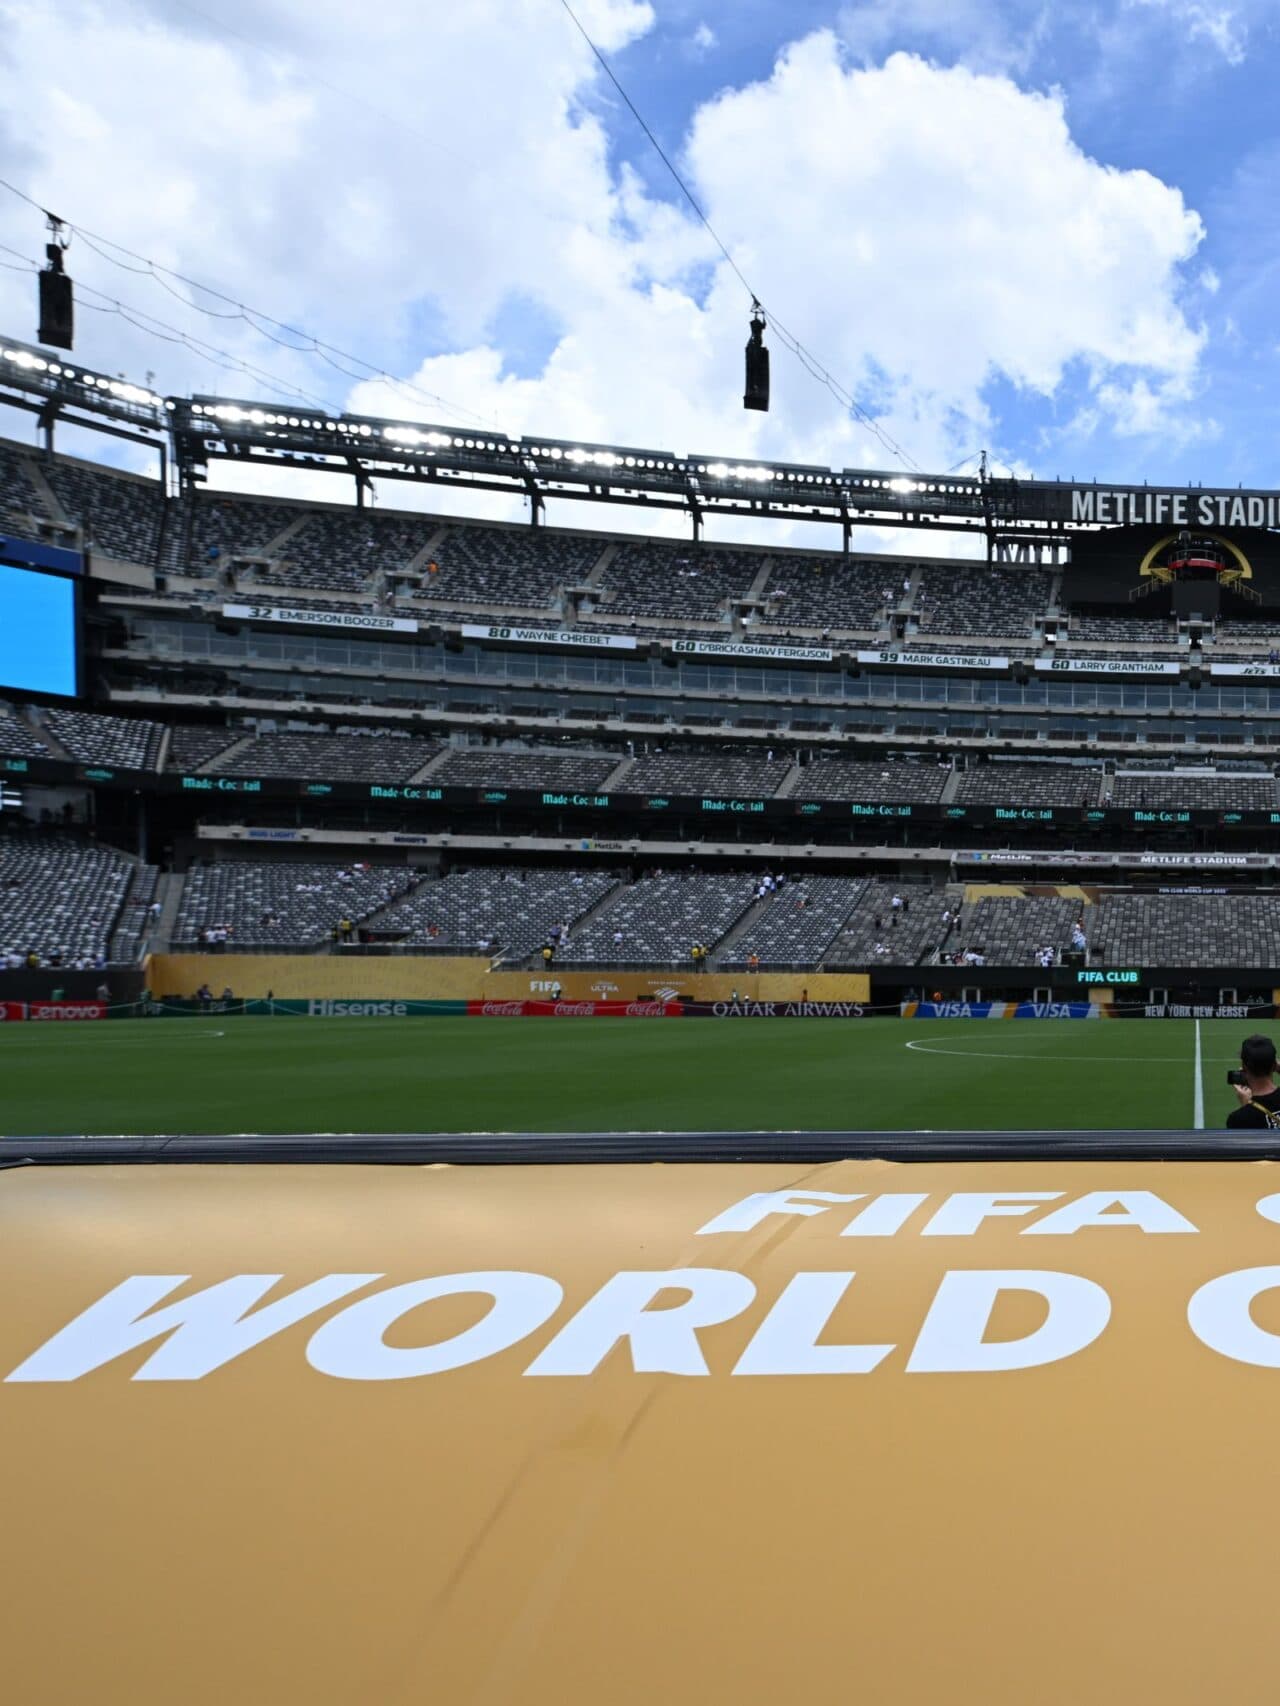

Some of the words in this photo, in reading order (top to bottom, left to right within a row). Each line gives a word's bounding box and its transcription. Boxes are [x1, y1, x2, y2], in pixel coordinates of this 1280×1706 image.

[1071, 490, 1188, 524] METLIFE
[248, 607, 272, 619] 32
[279, 610, 342, 624] EMERSON
[343, 616, 394, 628] BOOZER
[488, 626, 511, 639] 80
[516, 629, 559, 642] WAYNE
[560, 633, 611, 646] CHREBET
[675, 640, 697, 651] 60
[776, 646, 831, 660] FERGUSON
[879, 651, 899, 663] 99
[903, 653, 934, 664] MARK
[935, 655, 991, 667] GASTINEAU
[1051, 660, 1070, 670] 60
[1073, 660, 1106, 671] LARRY
[1107, 662, 1165, 673] GRANTHAM
[1140, 855, 1190, 864] METLIFE
[1194, 855, 1247, 864] STADIUM
[1077, 971, 1104, 983] FIFA
[1106, 971, 1139, 983] CLUB
[530, 980, 562, 992] FIFA
[308, 1000, 408, 1016] Hisense
[712, 1001, 776, 1017] QATAR
[784, 1001, 865, 1017] AIRWAYS
[933, 1003, 972, 1017] VISA
[1032, 1003, 1071, 1017] VISA
[1144, 1005, 1165, 1017] NEW
[1167, 1005, 1192, 1017] YORK
[1193, 1005, 1214, 1017] NEW
[1215, 1005, 1249, 1017] JERSEY
[695, 1190, 1200, 1237] FIFA
[4, 1269, 1112, 1382] WORLD
